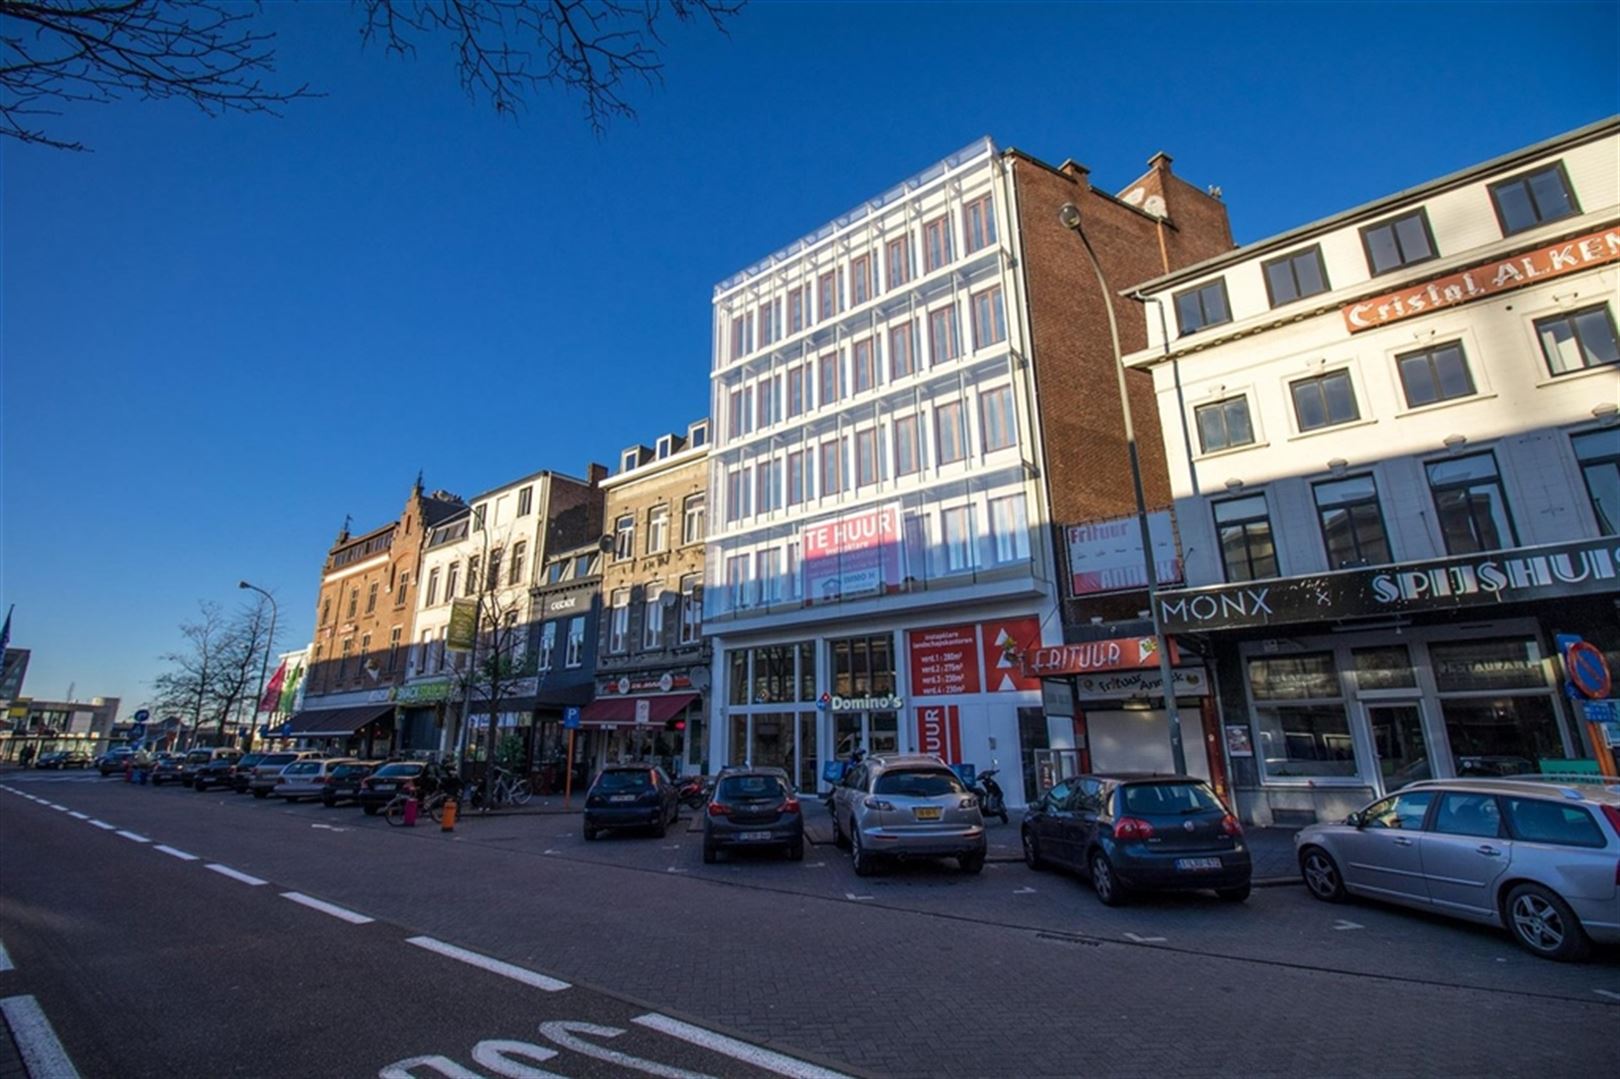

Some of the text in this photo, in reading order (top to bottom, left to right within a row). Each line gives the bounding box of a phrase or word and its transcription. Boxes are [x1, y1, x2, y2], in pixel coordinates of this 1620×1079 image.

[806, 511, 891, 551] TE HUUR
[1070, 522, 1128, 544] Frituur
[1372, 547, 1620, 602] SPIJSHUI
[1161, 588, 1273, 624] MONX
[1032, 642, 1120, 672] FRITUUR
[568, 708, 577, 721] P
[832, 693, 903, 710] Domino's
